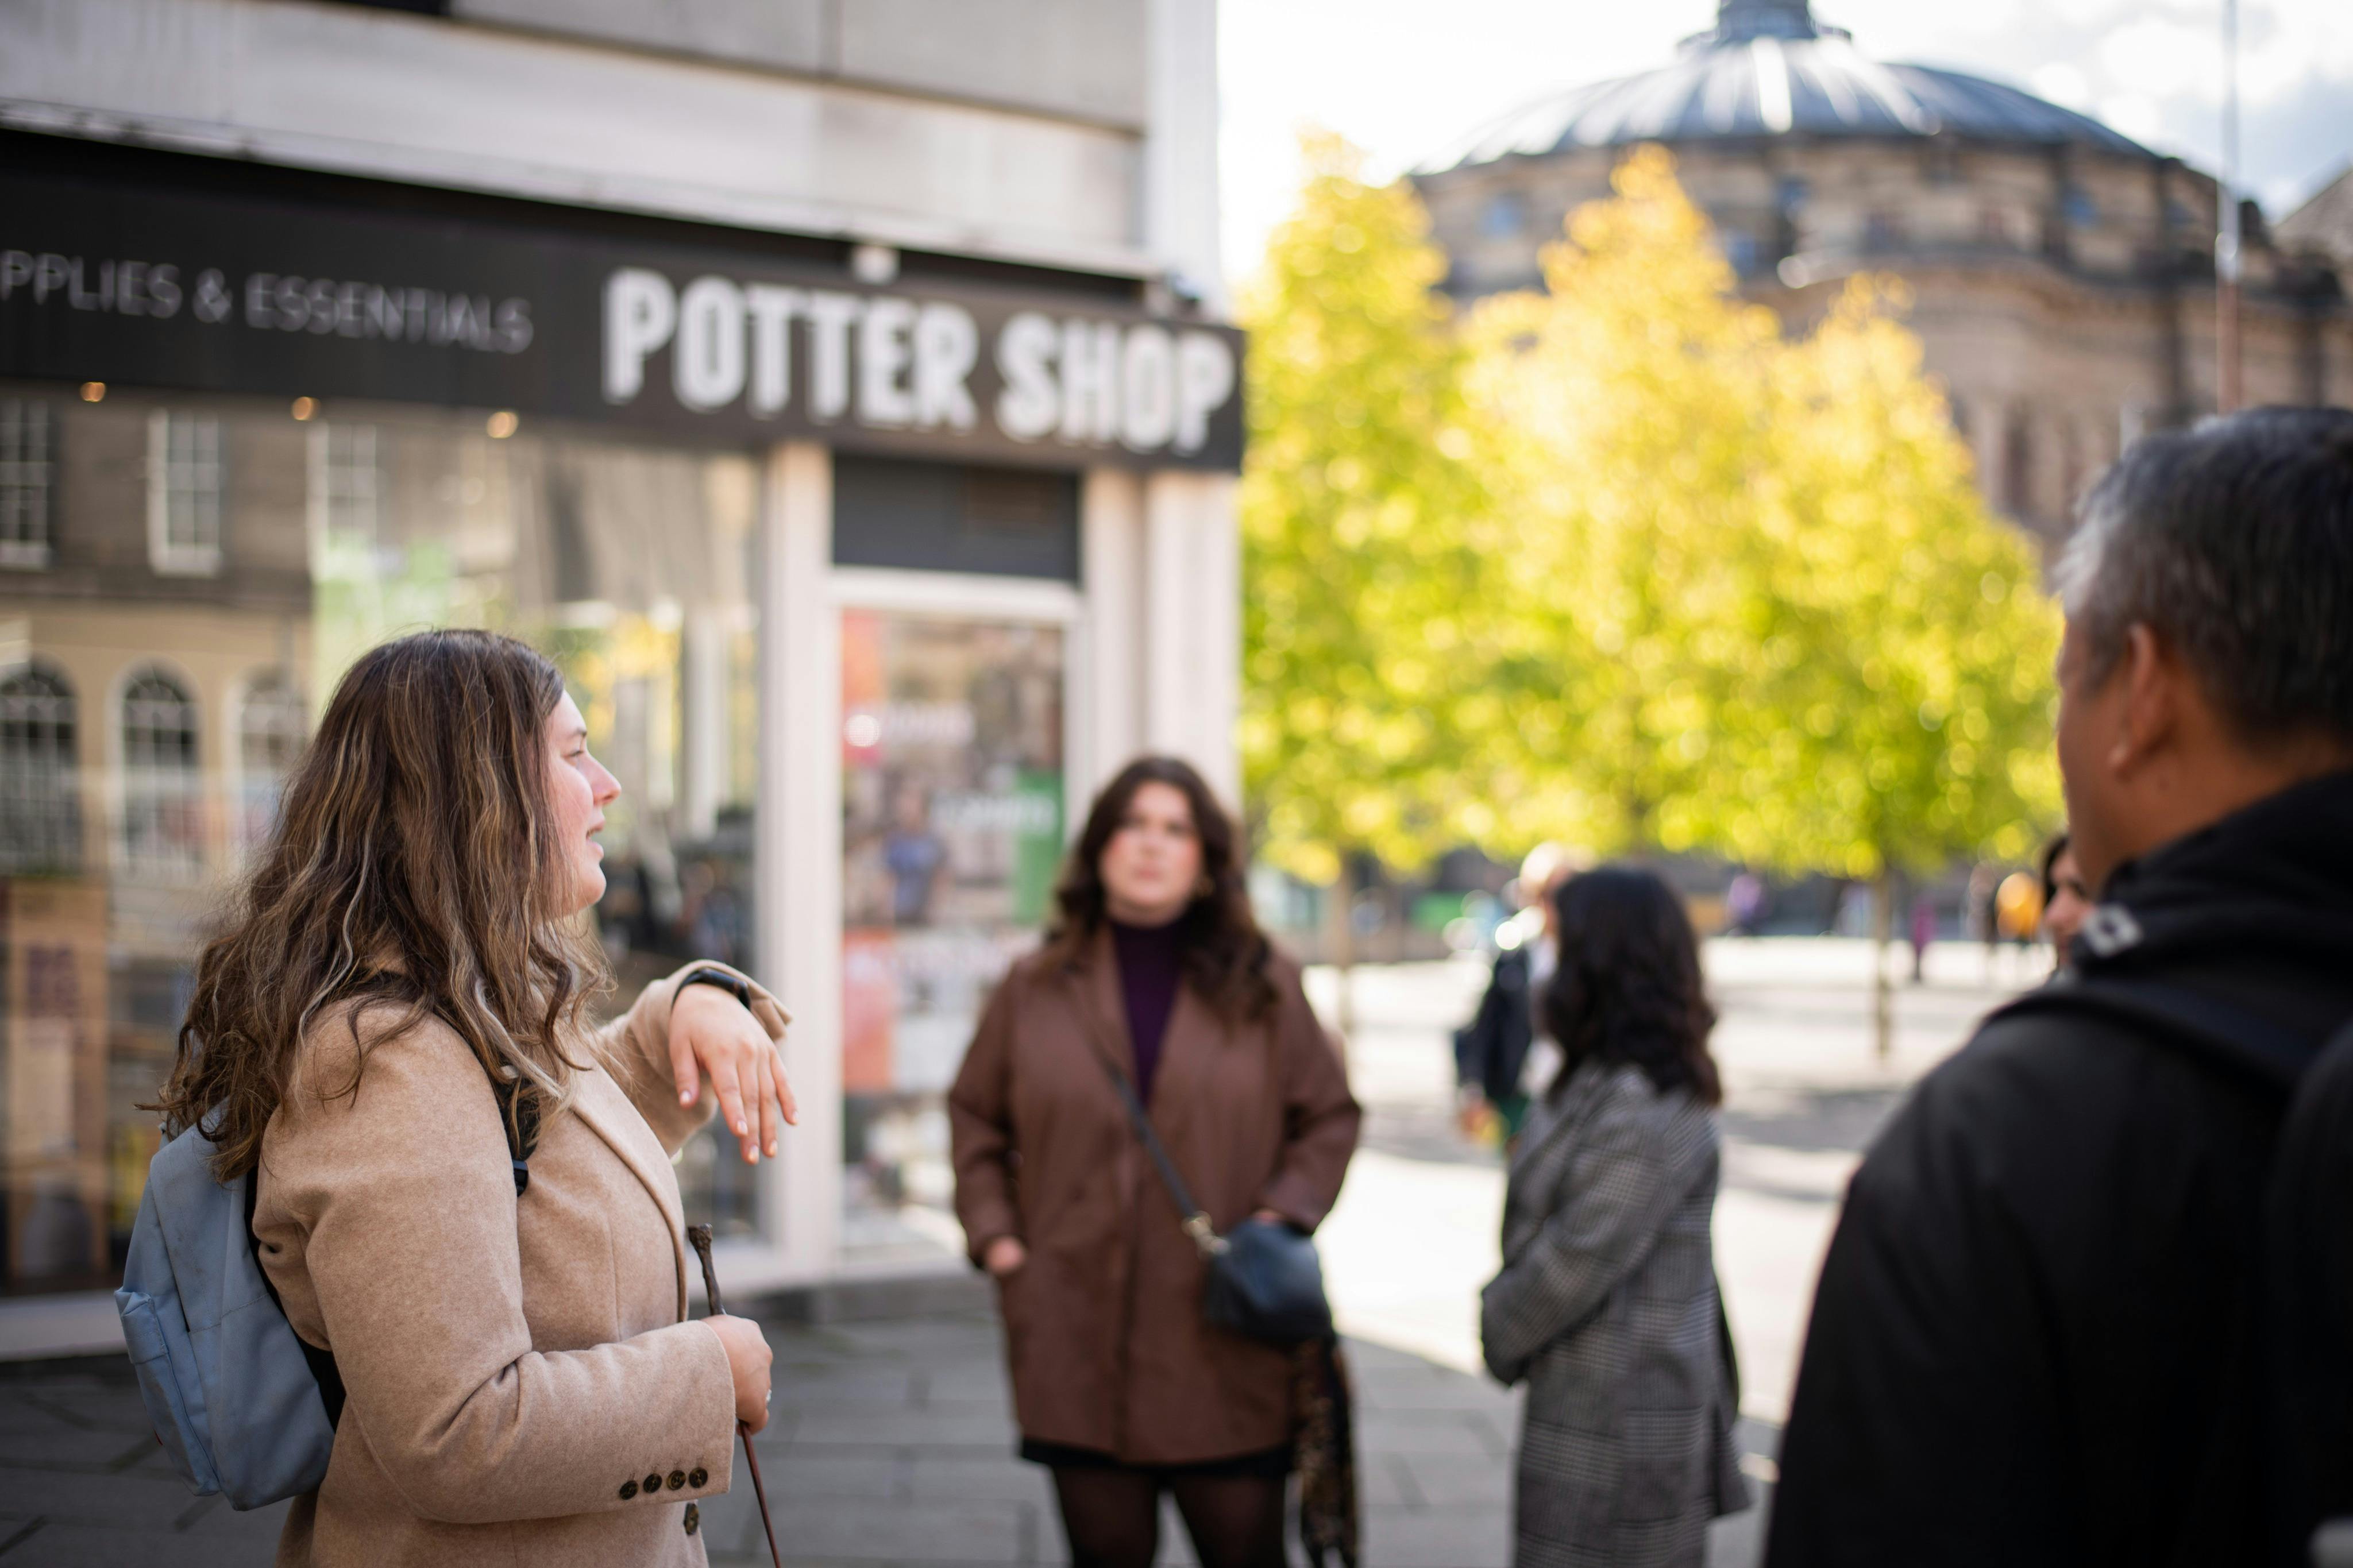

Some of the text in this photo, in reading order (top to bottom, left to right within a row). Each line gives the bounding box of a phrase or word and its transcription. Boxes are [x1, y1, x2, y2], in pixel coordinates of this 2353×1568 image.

[0, 250, 534, 354] PPLIES & ESSENTIALS
[601, 269, 1235, 454] POTTER SHOP
